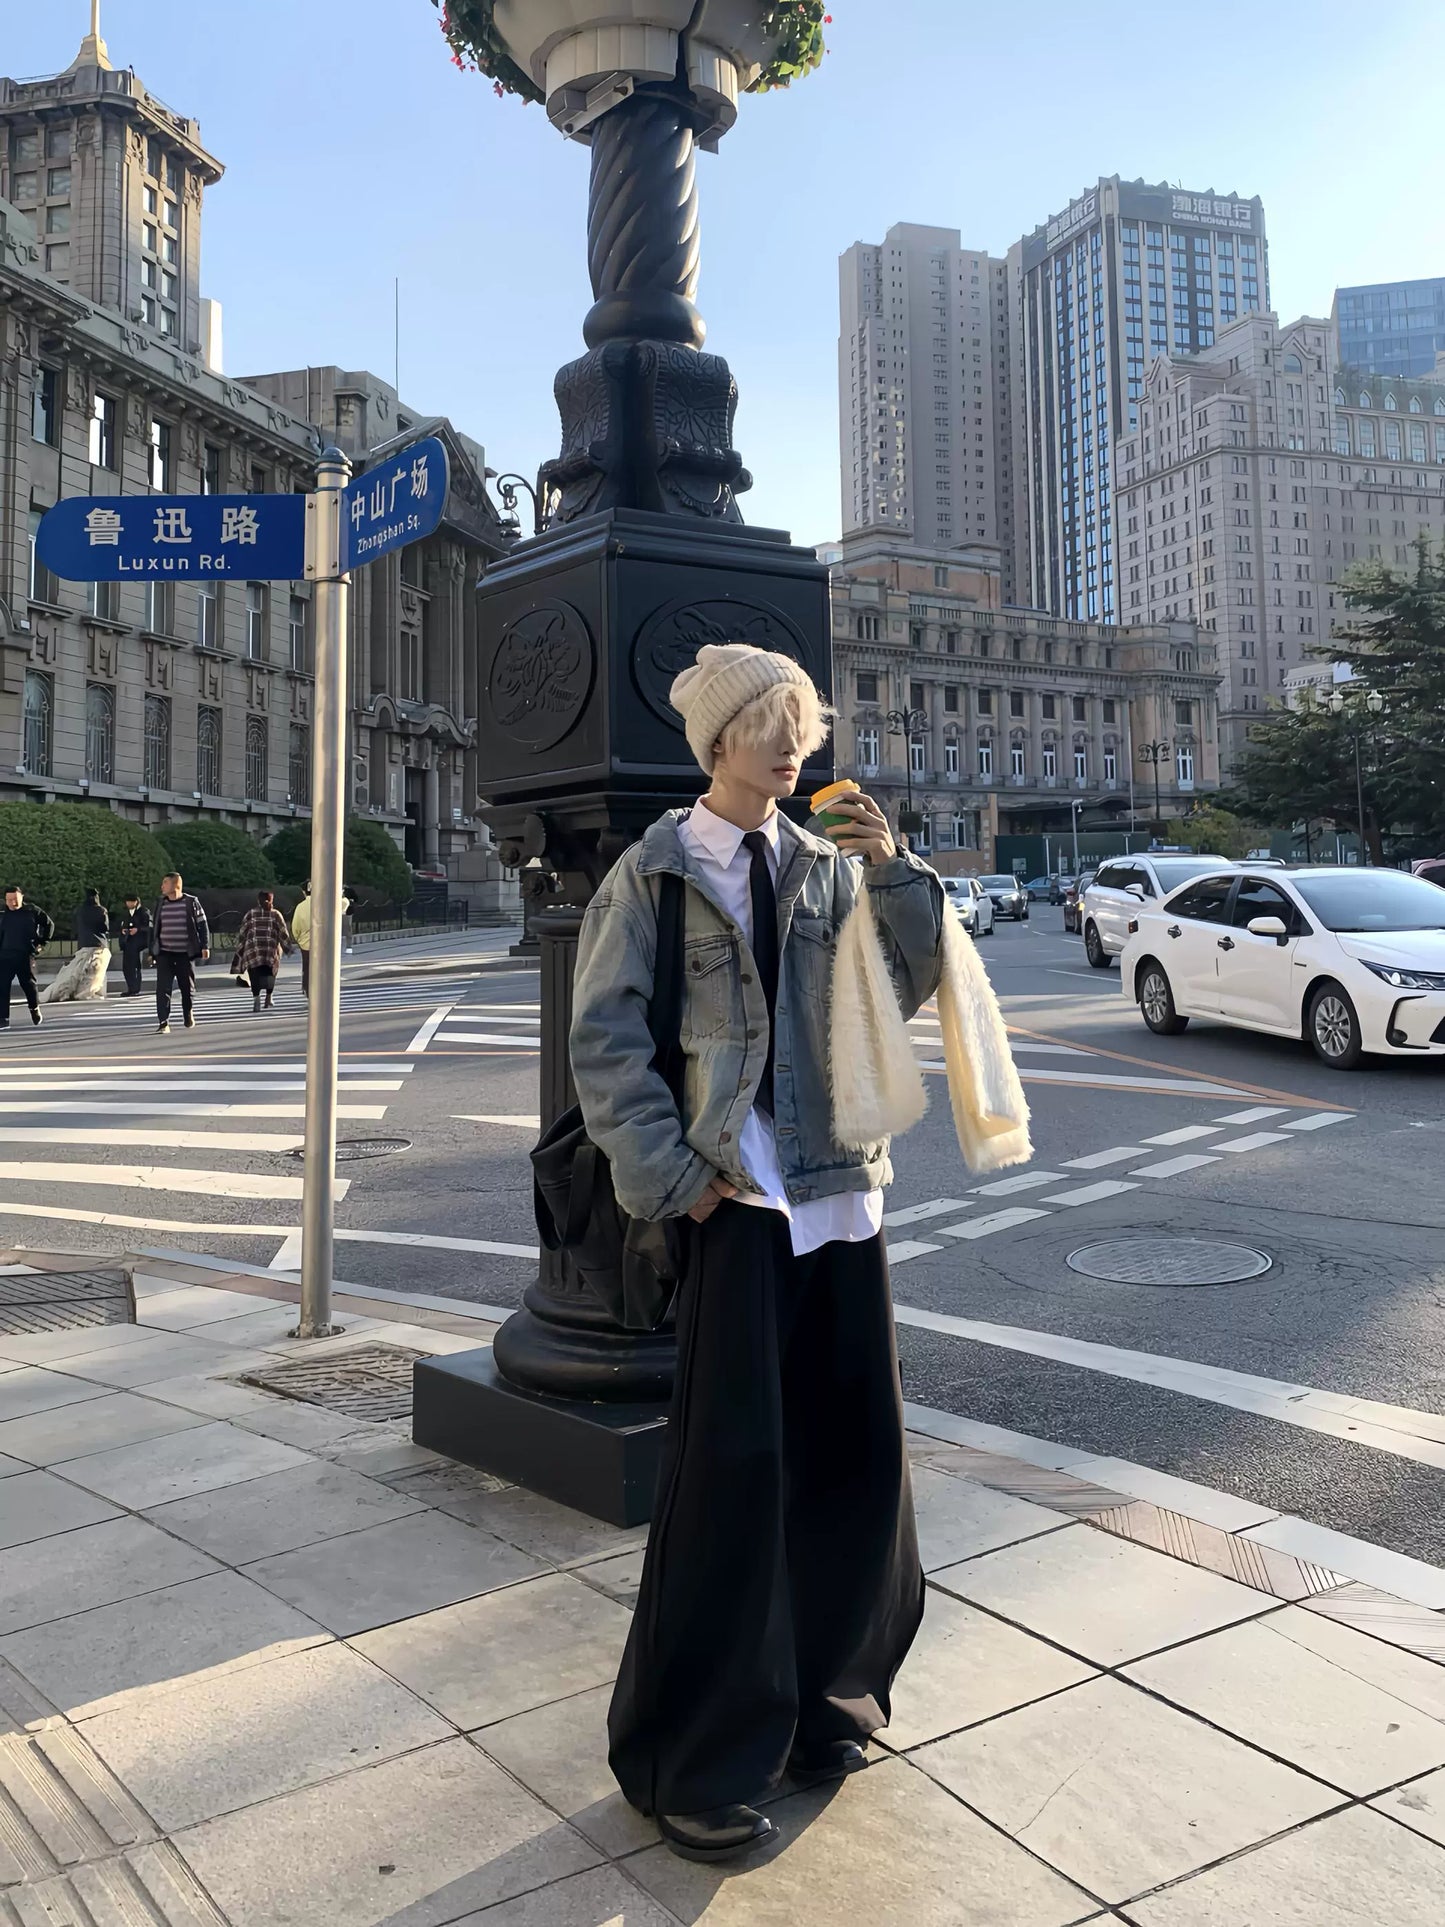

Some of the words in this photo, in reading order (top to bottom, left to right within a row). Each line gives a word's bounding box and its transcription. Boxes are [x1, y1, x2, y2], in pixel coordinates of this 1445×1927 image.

[352, 455, 428, 532] 中山广场
[84, 506, 260, 545] 鲁迅路
[357, 521, 404, 554] Zhongshan
[407, 514, 421, 530] Sq.
[118, 555, 189, 570] Luxun
[200, 554, 231, 570] Rd.
